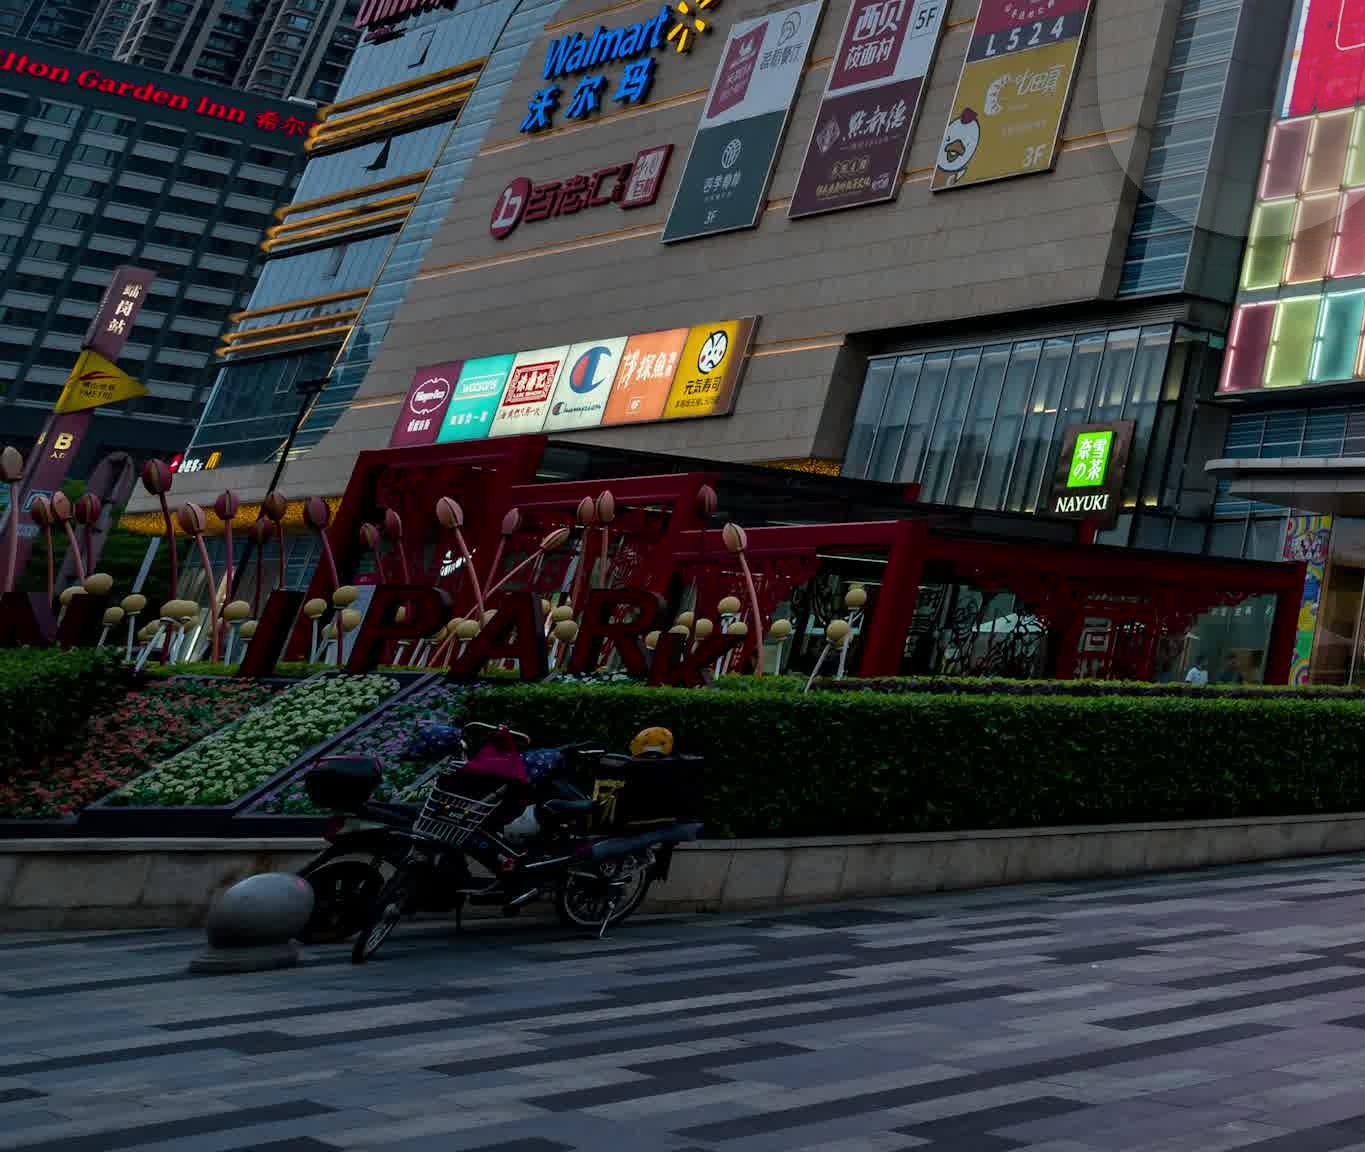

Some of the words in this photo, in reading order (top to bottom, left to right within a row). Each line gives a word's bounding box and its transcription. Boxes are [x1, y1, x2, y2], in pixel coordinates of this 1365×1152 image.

[914, 6, 939, 30] 5F
[543, 5, 672, 81] Walmart
[0, 49, 70, 85] lton
[75, 68, 190, 111] Garden
[194, 95, 247, 124] Inn
[255, 109, 318, 138] 希尔
[519, 56, 656, 134] 沃尔玛
[551, 401, 602, 418] Champion
[53, 432, 75, 451] B
[1054, 494, 1110, 513] NAYUKI
